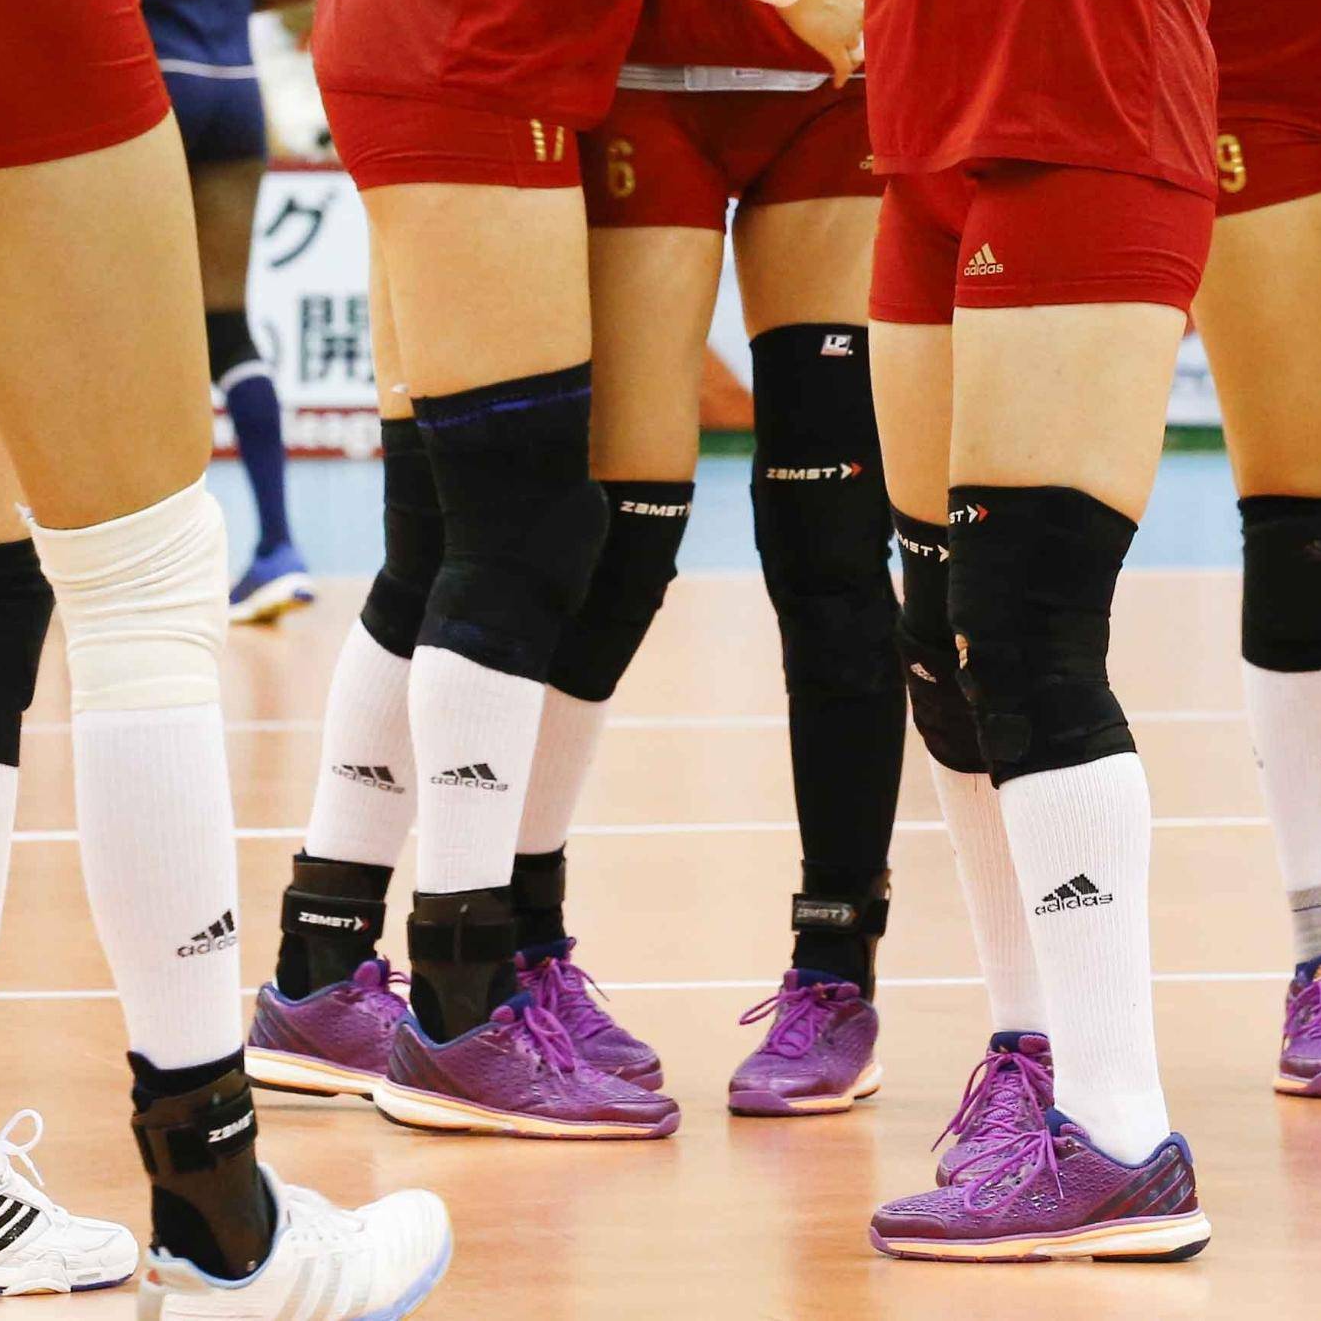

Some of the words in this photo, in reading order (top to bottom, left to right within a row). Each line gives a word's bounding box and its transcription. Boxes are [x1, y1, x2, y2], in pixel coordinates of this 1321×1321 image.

[607, 138, 635, 198] 6
[1216, 133, 1246, 193] 9
[964, 263, 1004, 276] adidas
[431, 775, 509, 793] adidas
[1035, 893, 1113, 915] adidas
